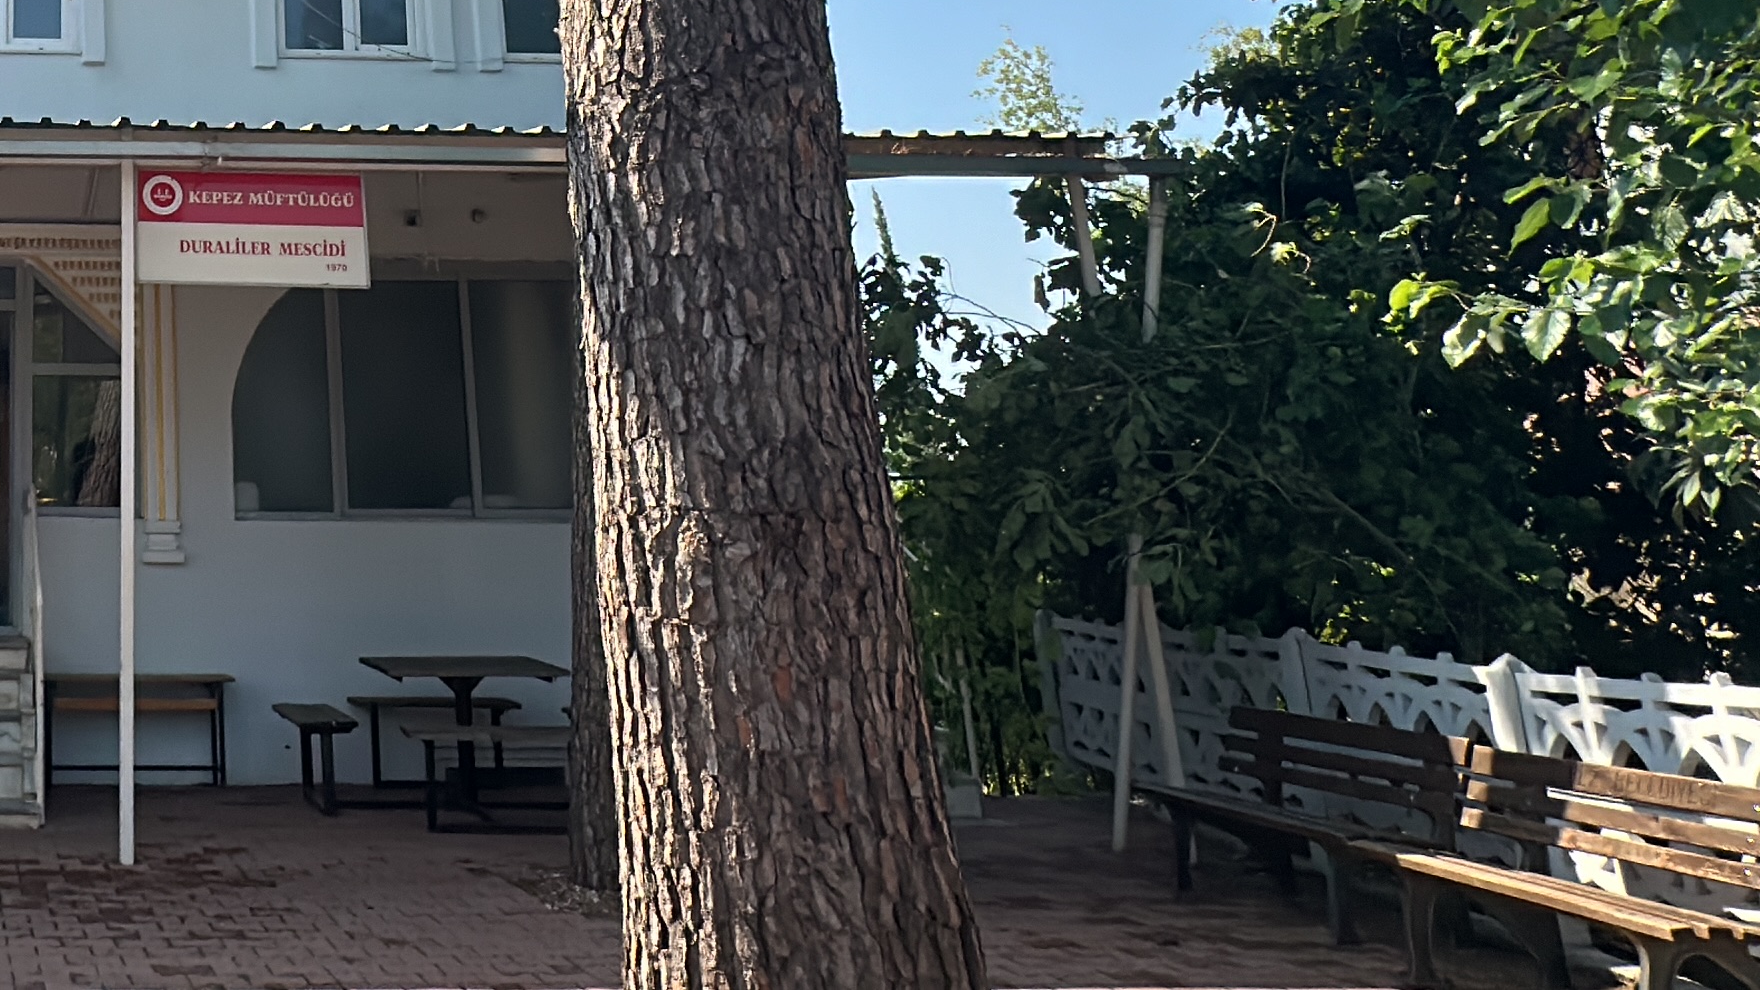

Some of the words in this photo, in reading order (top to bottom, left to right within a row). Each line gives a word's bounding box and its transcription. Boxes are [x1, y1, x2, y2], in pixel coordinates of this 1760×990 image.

[188, 190, 243, 205] KEPEZ
[248, 190, 355, 208] MÜFTÜLÜĞÜ
[179, 237, 271, 256] DURALİLER
[278, 239, 346, 257] MESCİDİ
